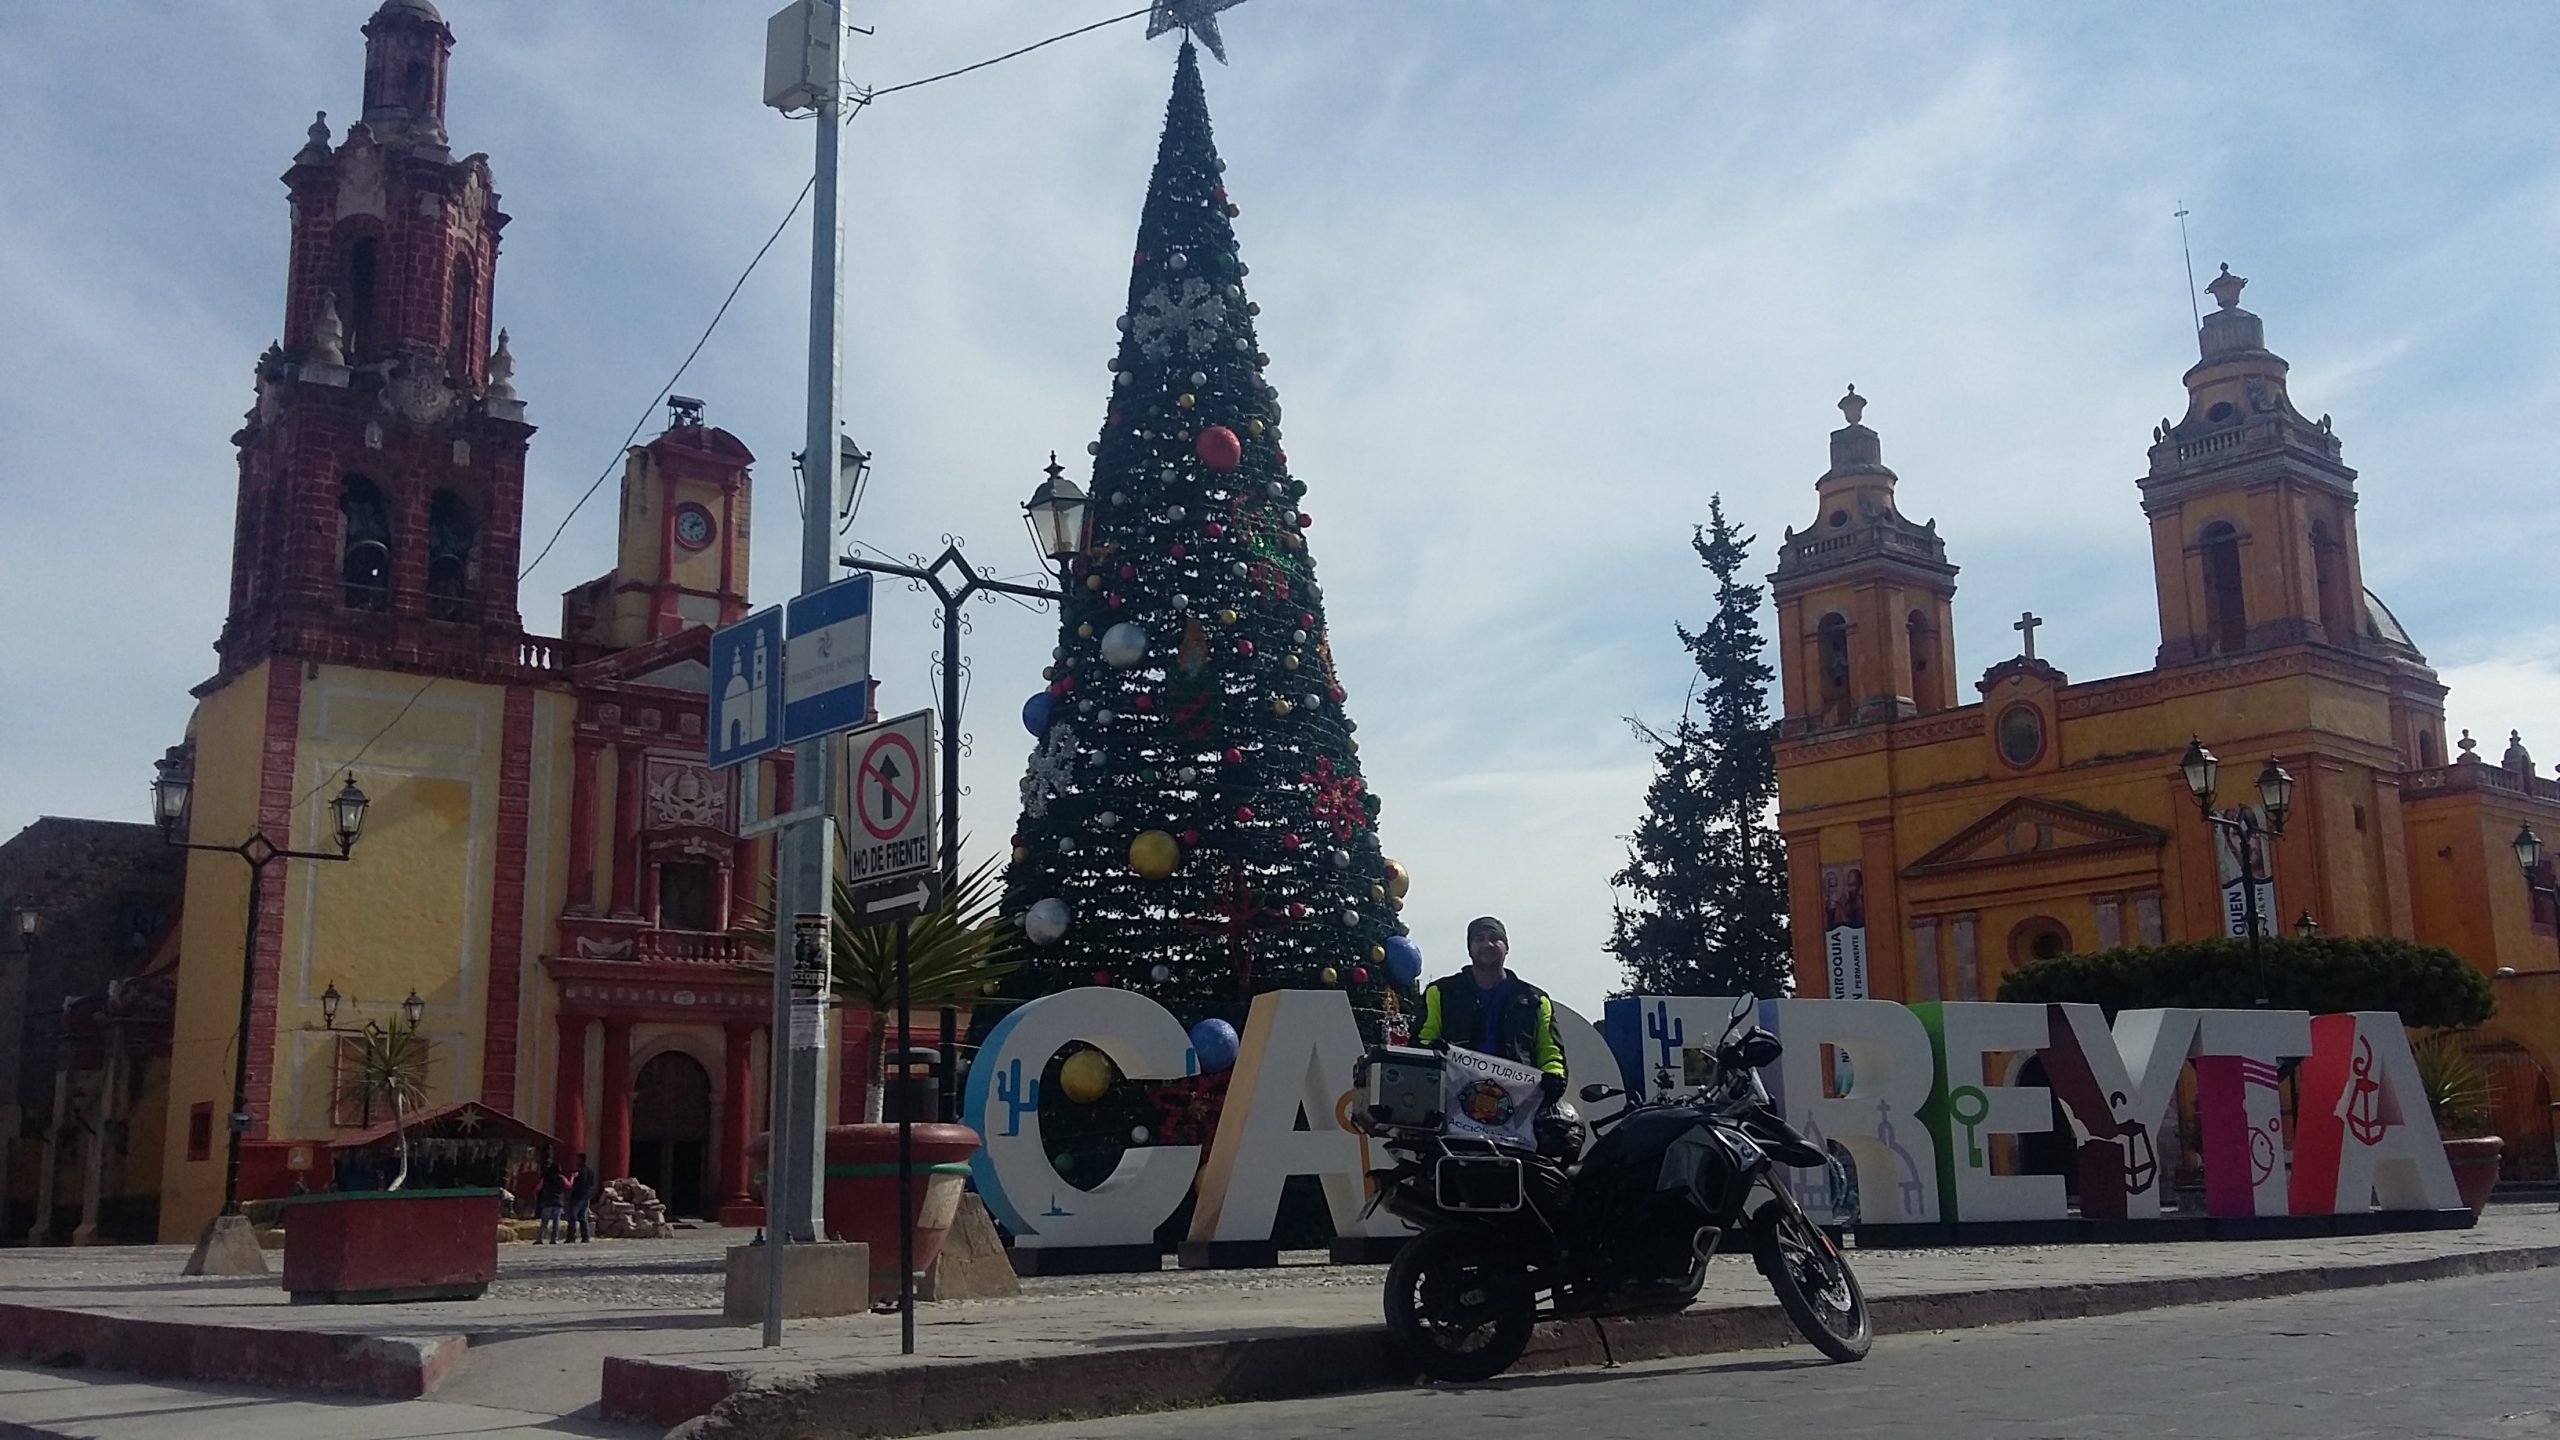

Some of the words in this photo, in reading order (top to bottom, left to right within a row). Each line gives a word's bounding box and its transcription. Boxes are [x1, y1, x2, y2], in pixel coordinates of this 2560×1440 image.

[853, 849, 868, 877] NO
[870, 845, 884, 873] DE
[886, 835, 927, 870] FRENTE
[1852, 934, 1863, 989] PERMANENTE
[1451, 1052, 1488, 1071] MOTO
[1491, 1063, 1536, 1084] TURISTA
